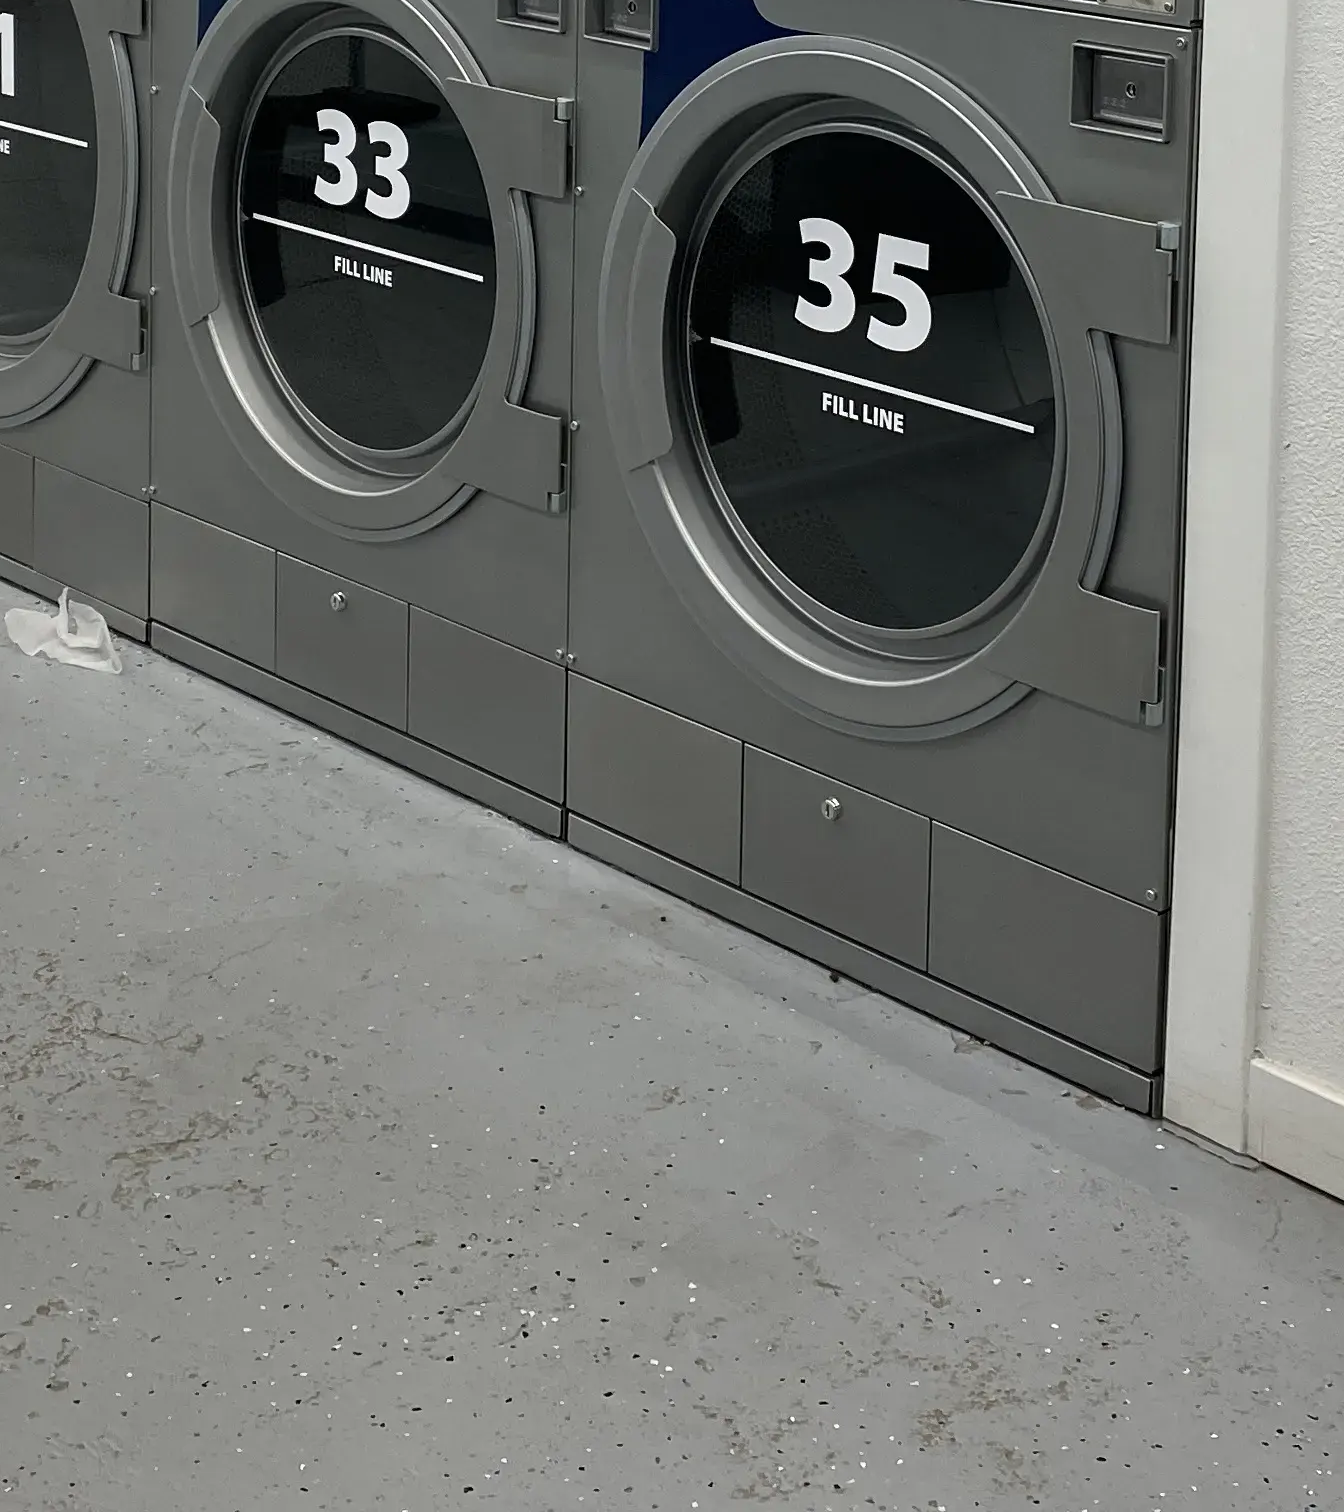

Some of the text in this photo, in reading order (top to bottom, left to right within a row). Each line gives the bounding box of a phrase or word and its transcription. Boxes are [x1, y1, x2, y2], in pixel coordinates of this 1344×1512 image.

[313, 108, 411, 220] 33
[335, 255, 392, 287] FILL LINE
[794, 217, 932, 352] 35
[822, 392, 904, 434] FILL LINE
